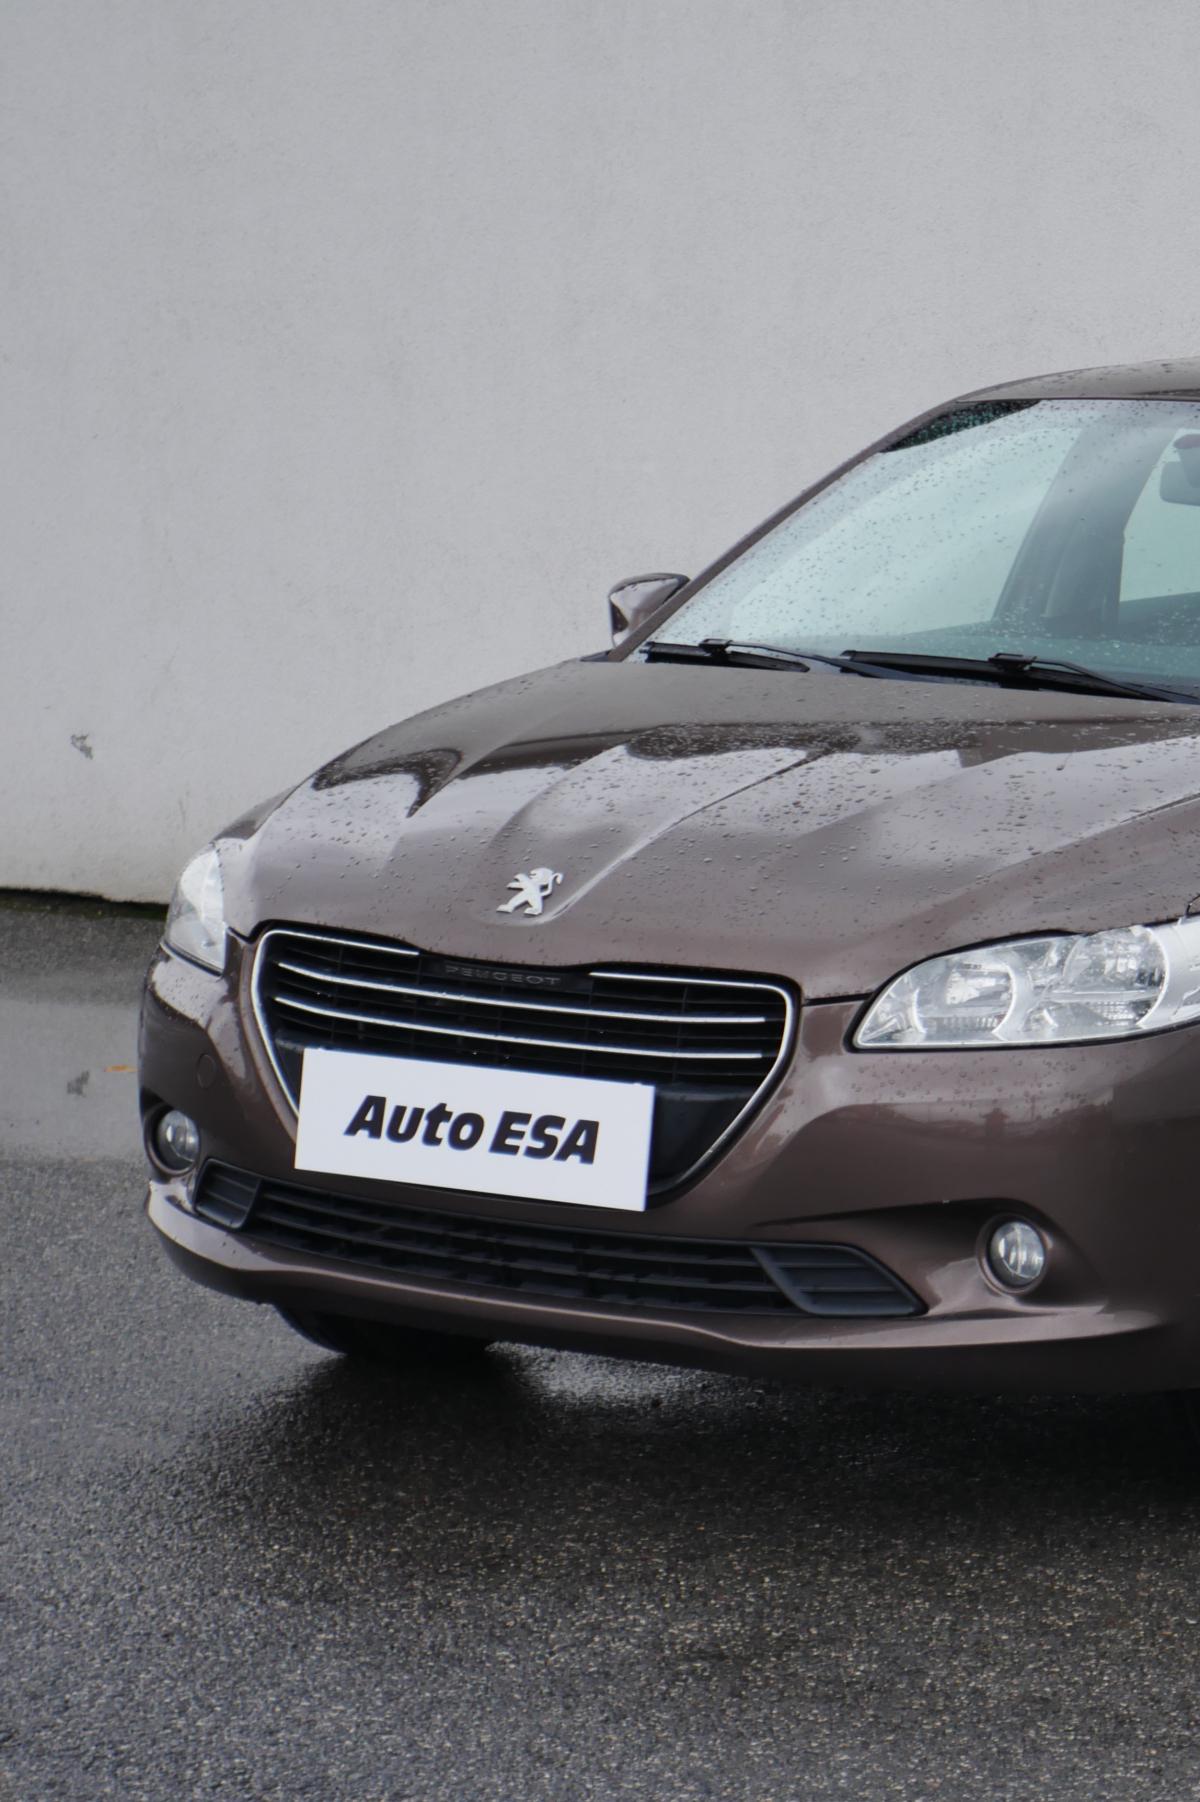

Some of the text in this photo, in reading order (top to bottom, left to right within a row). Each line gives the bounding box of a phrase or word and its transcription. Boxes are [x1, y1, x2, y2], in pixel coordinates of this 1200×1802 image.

[445, 965, 561, 985] PEUGEOT
[344, 1095, 600, 1164] Auto ESA
